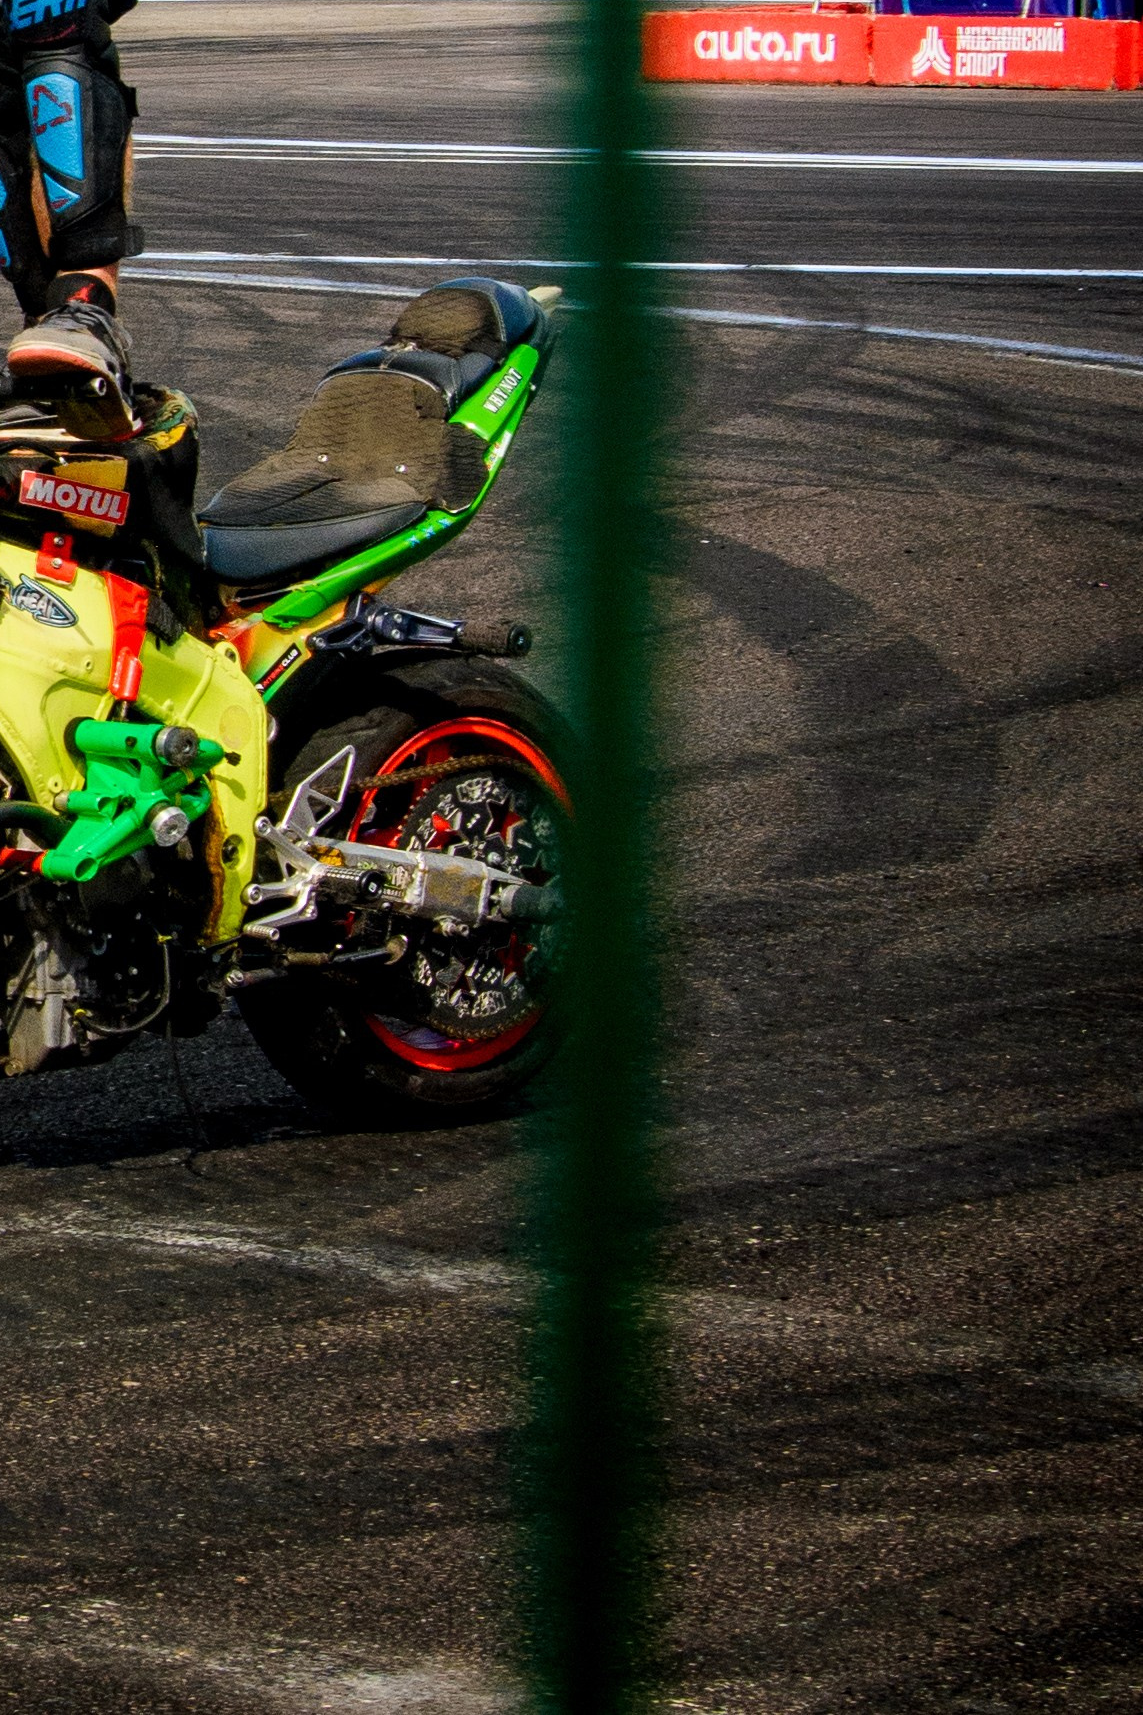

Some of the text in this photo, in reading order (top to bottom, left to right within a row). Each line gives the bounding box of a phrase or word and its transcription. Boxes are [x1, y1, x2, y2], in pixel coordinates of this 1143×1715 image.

[694, 26, 835, 62] auto.ru
[956, 22, 1064, 53] МОСКОВСКИЙ
[955, 52, 1007, 77] СПОРТ
[483, 367, 522, 413] WHY NOT
[26, 477, 122, 519] MOTUL
